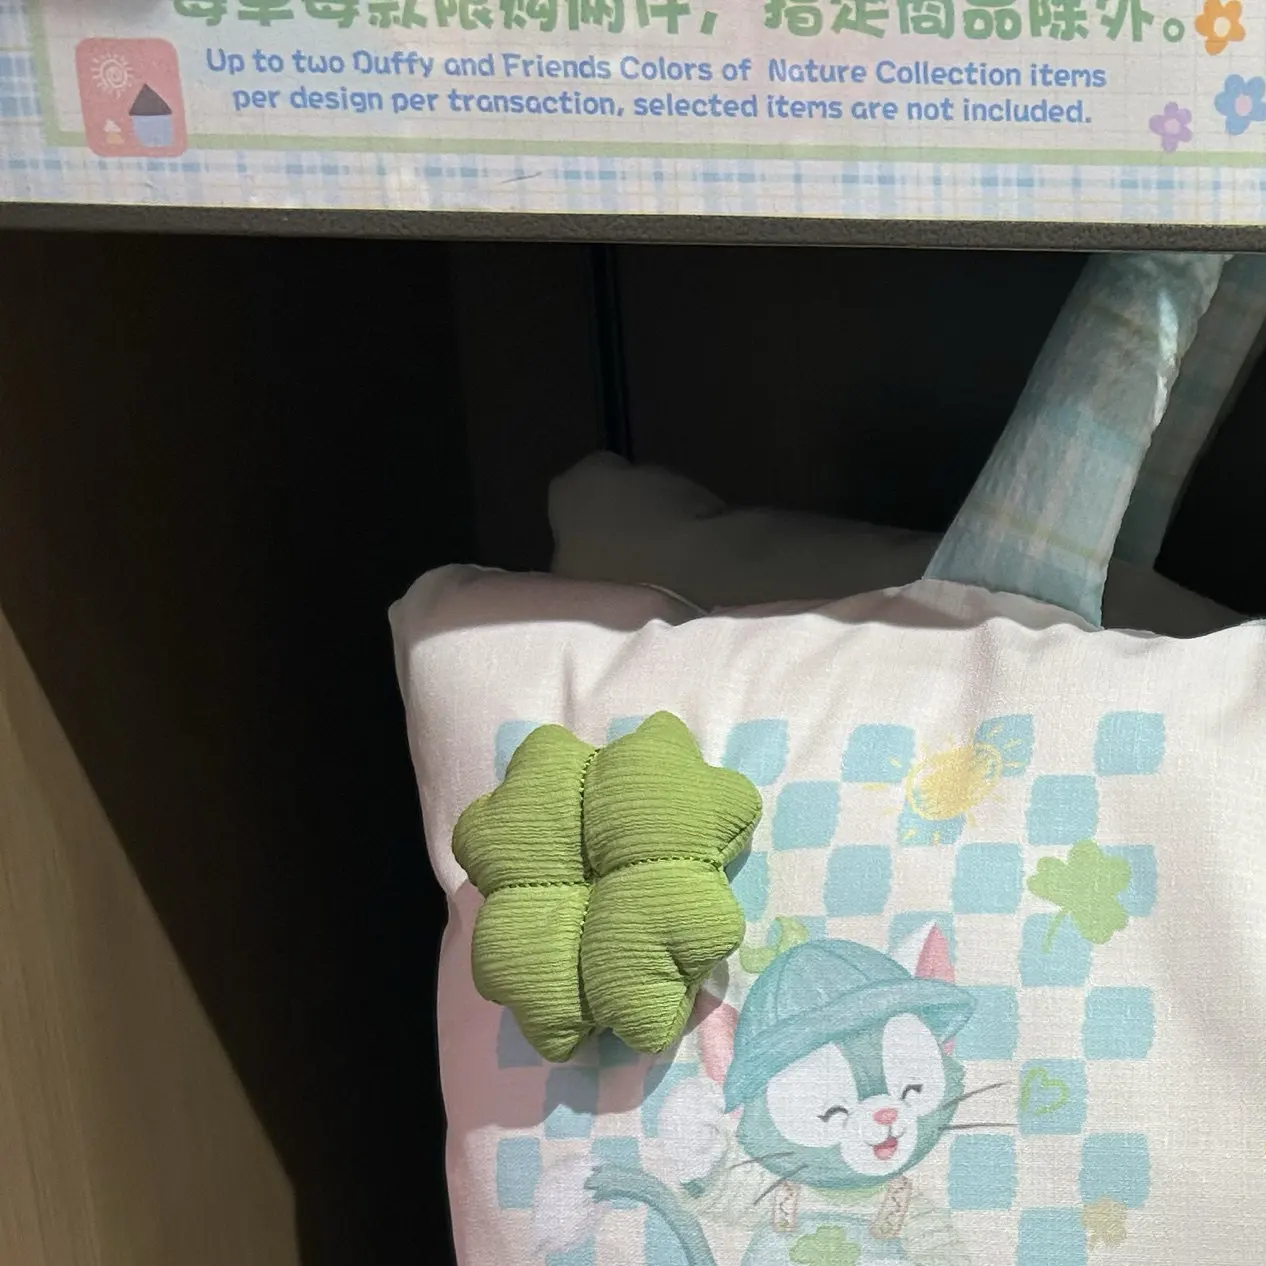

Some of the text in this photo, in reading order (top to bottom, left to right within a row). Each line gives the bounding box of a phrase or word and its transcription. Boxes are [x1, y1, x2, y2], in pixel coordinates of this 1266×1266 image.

[206, 48, 1107, 88] Up to two Duffy and Friends Colors of Nature Collection items
[232, 86, 1093, 123] per design per transaction, selected items are not included.
